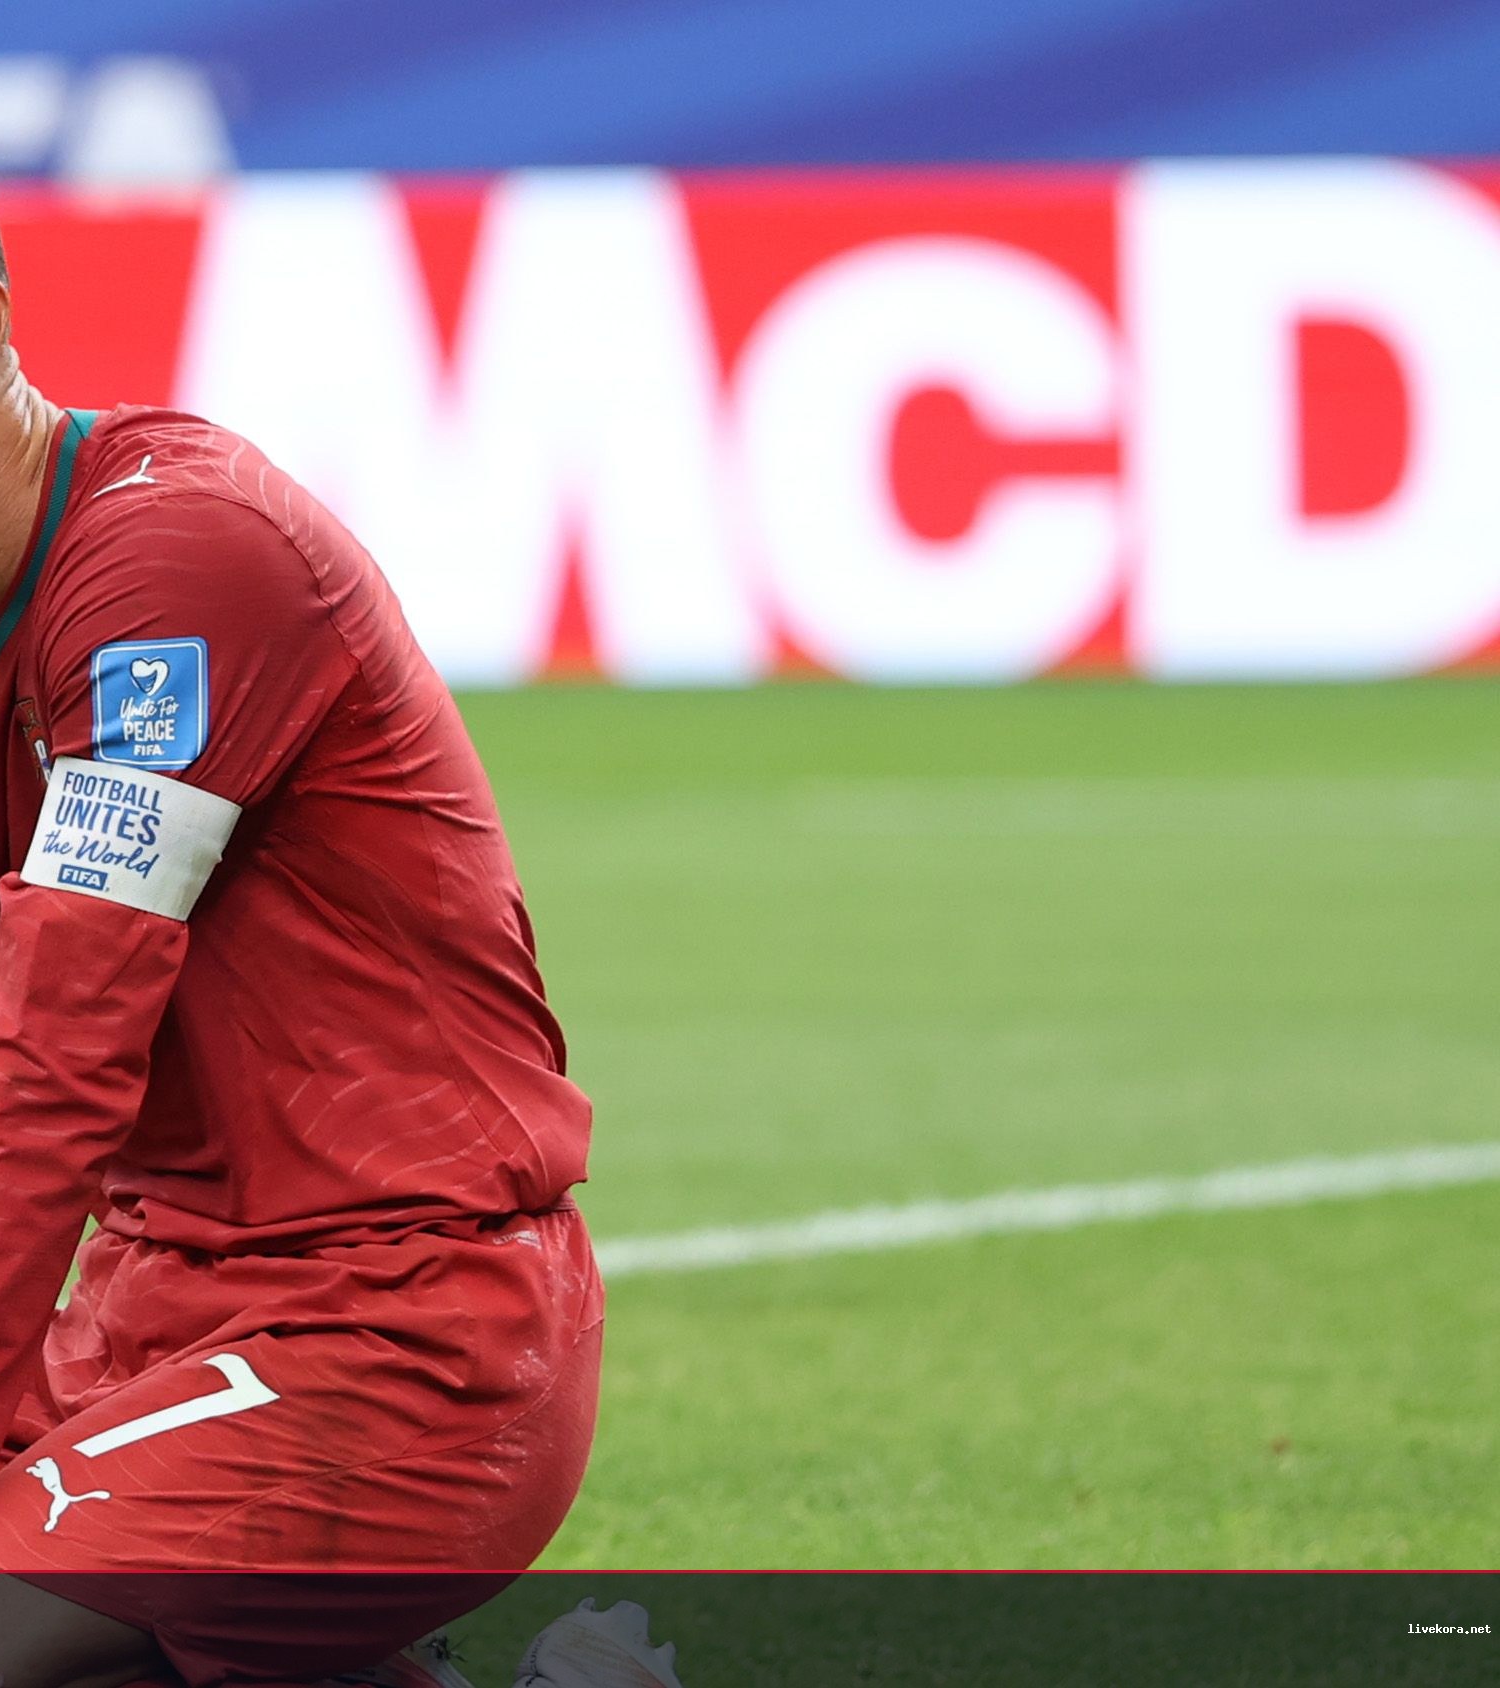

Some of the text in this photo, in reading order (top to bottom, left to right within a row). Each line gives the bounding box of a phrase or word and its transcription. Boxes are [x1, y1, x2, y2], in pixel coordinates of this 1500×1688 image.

[120, 695, 180, 720] Unite For
[123, 719, 176, 741] PEACE
[133, 744, 164, 756] FIFA
[62, 771, 163, 814] FOOTBALL
[55, 795, 160, 846] UNITES
[42, 829, 160, 879] the World
[60, 866, 103, 888] FIFA
[71, 1353, 281, 1458] 7
